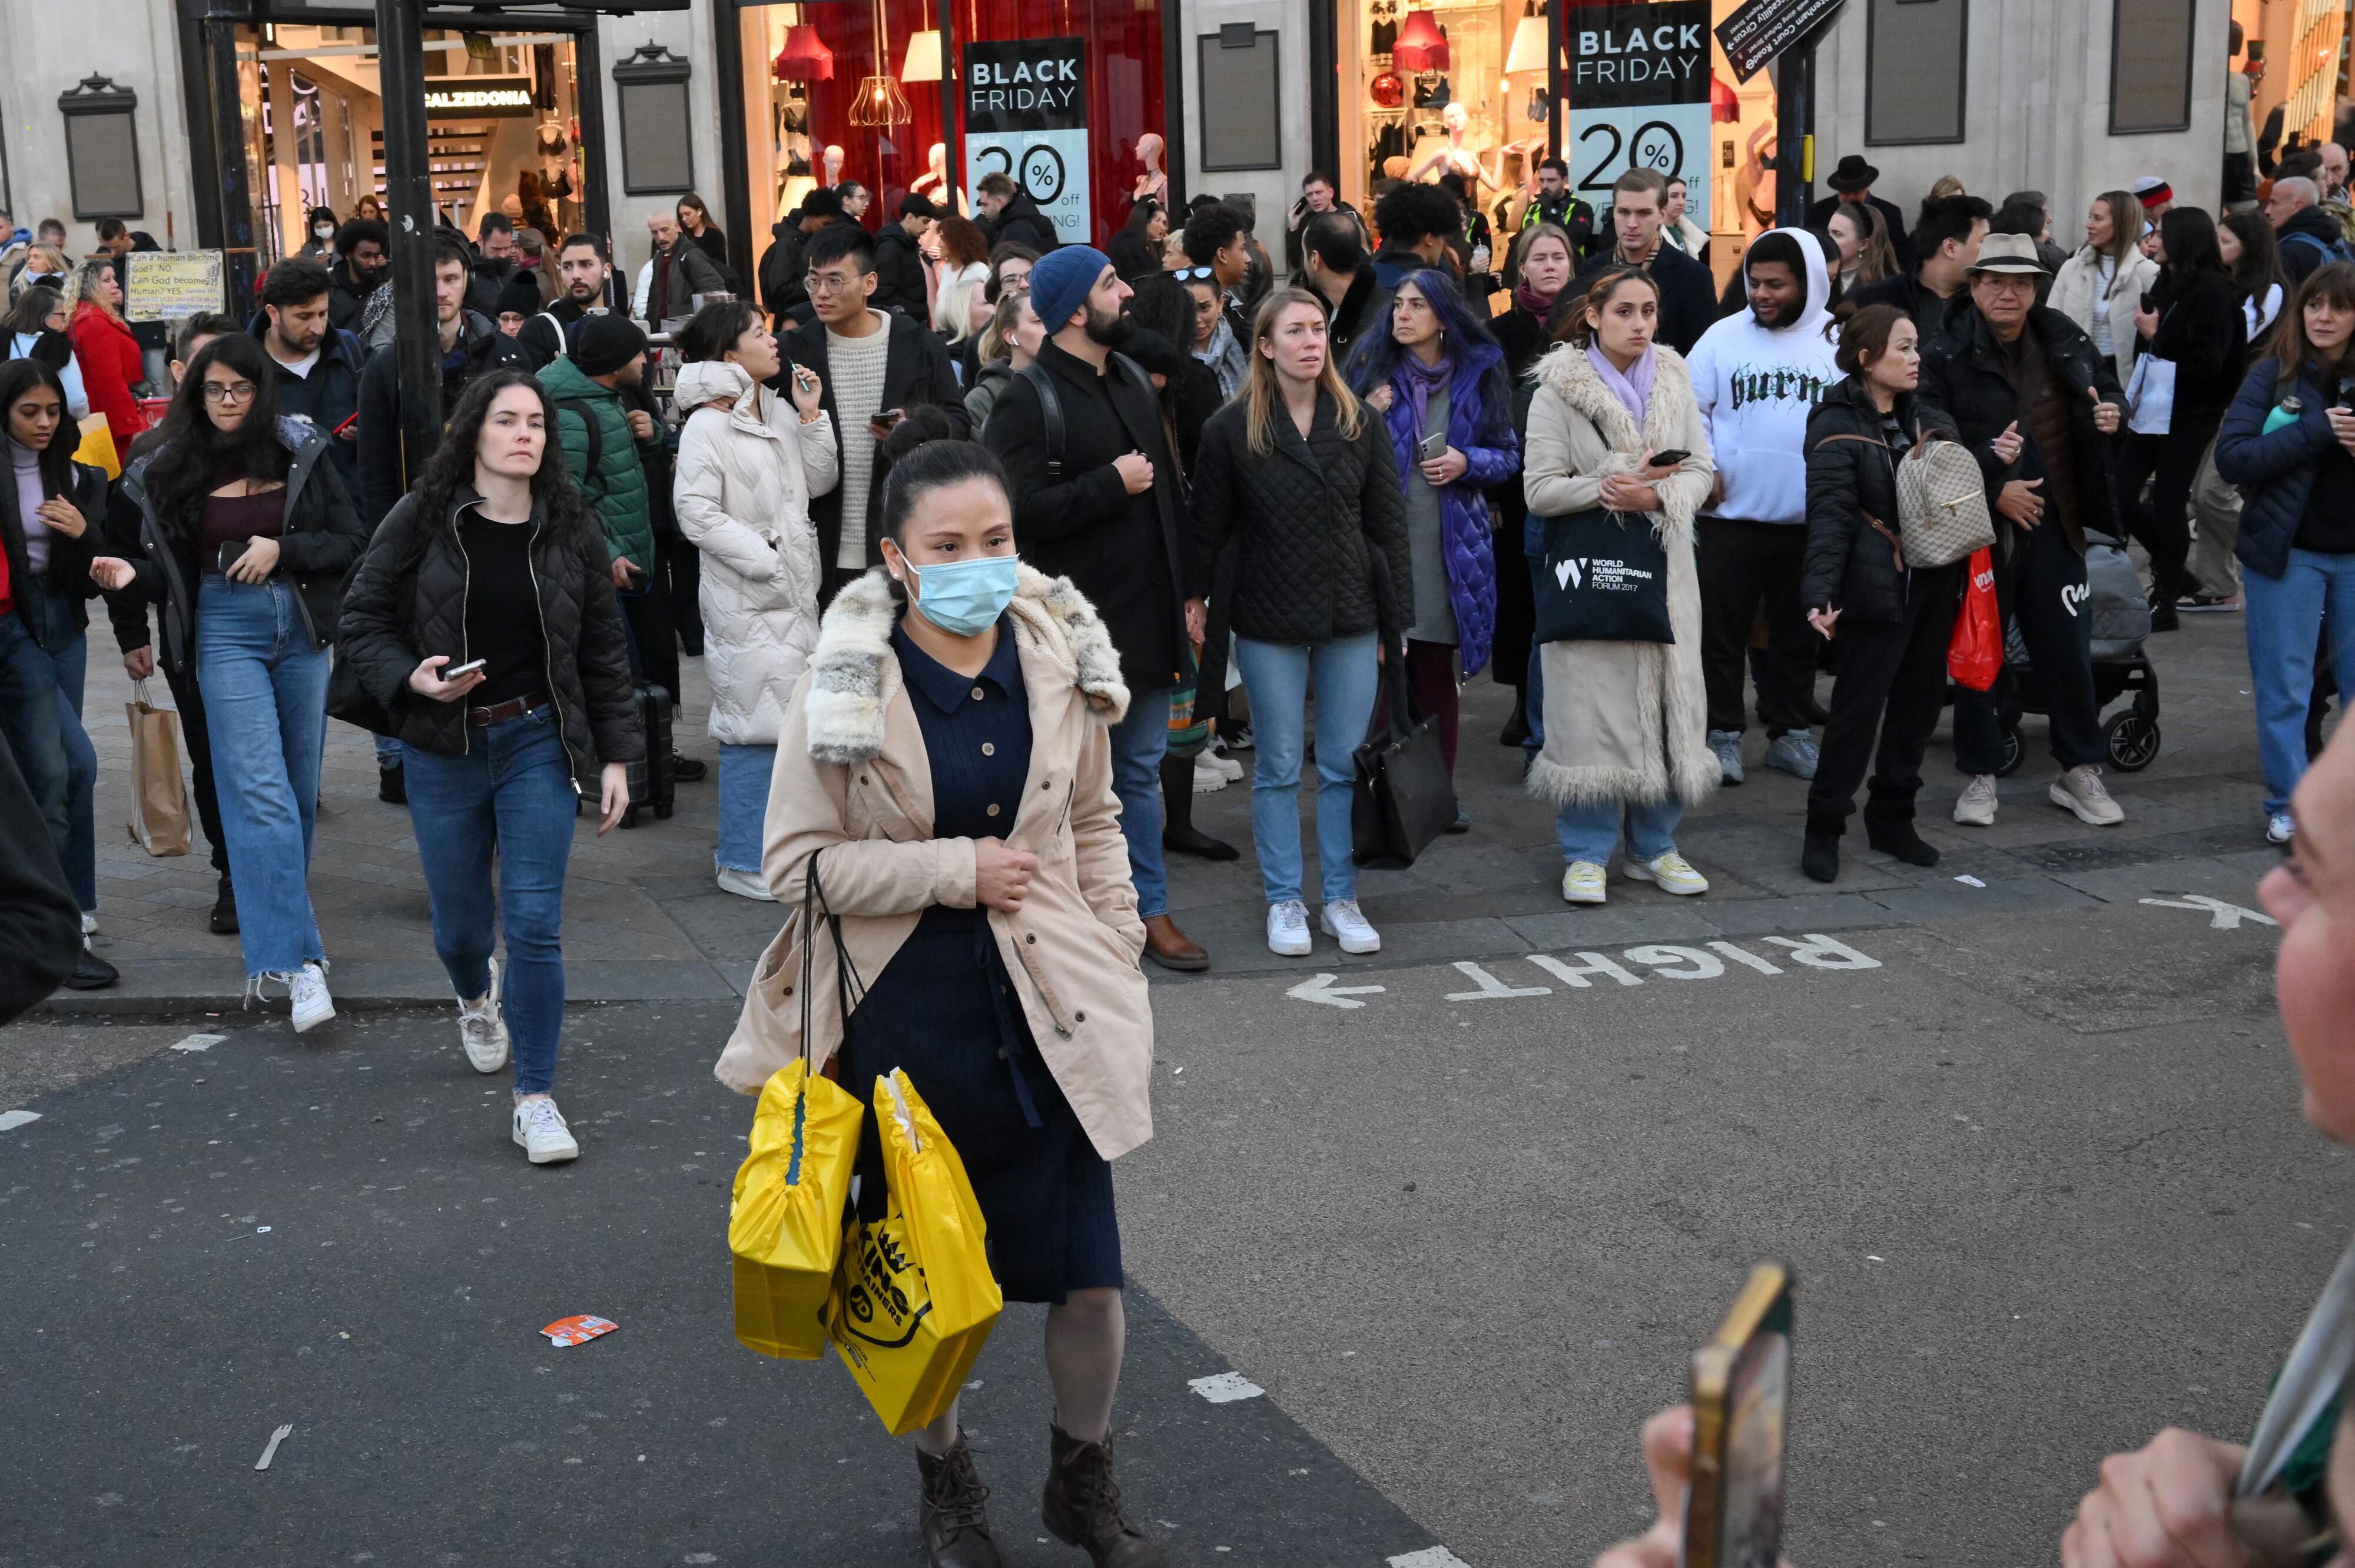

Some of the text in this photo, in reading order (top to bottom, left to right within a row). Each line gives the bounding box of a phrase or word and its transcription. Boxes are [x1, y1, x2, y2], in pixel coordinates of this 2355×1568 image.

[1730, 18, 1746, 34] Street
[1733, 0, 1789, 44] cadilly Circus
[1748, 0, 1810, 53] walk along Oxford Street
[1754, 0, 1830, 64] tenham Court Road
[1579, 24, 1701, 55] BLACK
[973, 59, 1077, 85] BLACK
[1577, 55, 1698, 84] FRIDAY
[971, 86, 1074, 111] FRIDAY
[1689, 177, 1700, 189] ff
[1061, 194, 1080, 206] off
[131, 276, 205, 285] Can God become
[132, 265, 153, 273] God?
[1592, 559, 1624, 567] WORLD
[1592, 567, 1652, 579] HUMANITARIAN
[1592, 582, 1638, 592] FORUM 2017
[1443, 934, 1883, 1002] RIGHT
[858, 1223, 908, 1316] KING
